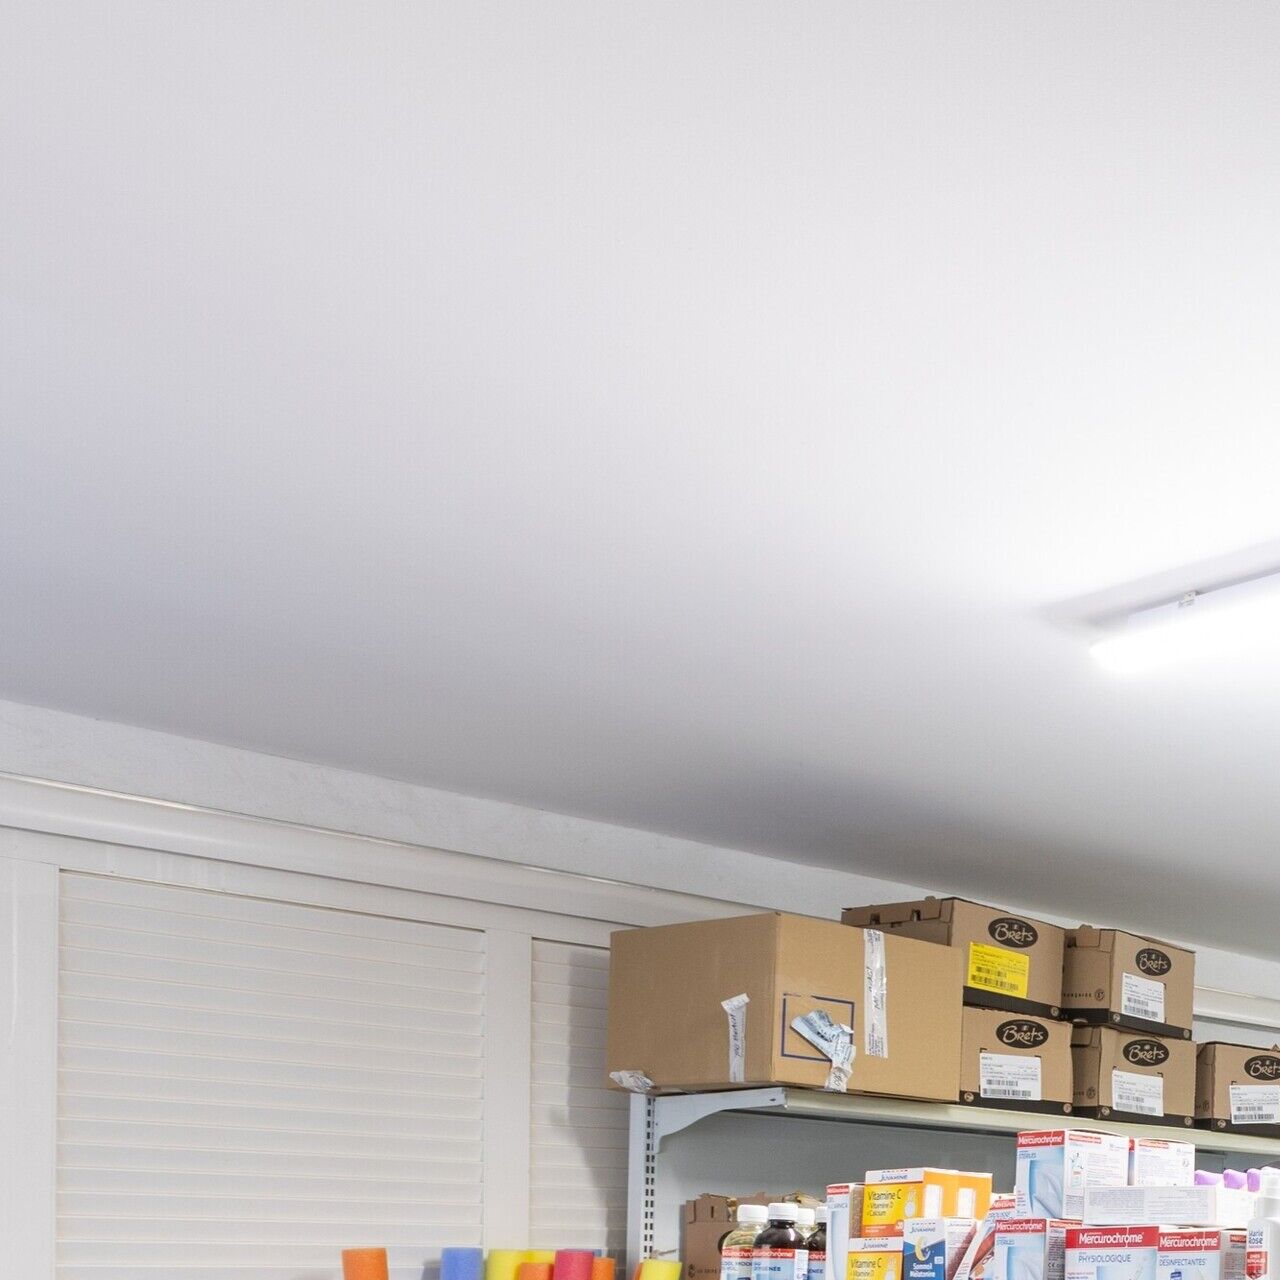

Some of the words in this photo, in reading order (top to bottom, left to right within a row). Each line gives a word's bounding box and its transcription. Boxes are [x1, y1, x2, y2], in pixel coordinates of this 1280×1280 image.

[994, 923, 1034, 944] Brets
[1139, 955, 1169, 972] Brets
[1003, 1025, 1046, 1042] Brets
[1128, 1046, 1166, 1063] Brets
[1017, 1134, 1064, 1146] Mercurochrome
[868, 1190, 896, 1200] Vitamine
[896, 1188, 902, 1200] C
[996, 1222, 1045, 1233] Mercurochrome
[1078, 1231, 1143, 1245] Mercurochrome
[1159, 1236, 1219, 1248] Mercurochrome
[850, 1258, 876, 1268] Vitamine
[876, 1257, 882, 1268] C
[1078, 1252, 1132, 1263] PHYSIOLOGIQUE
